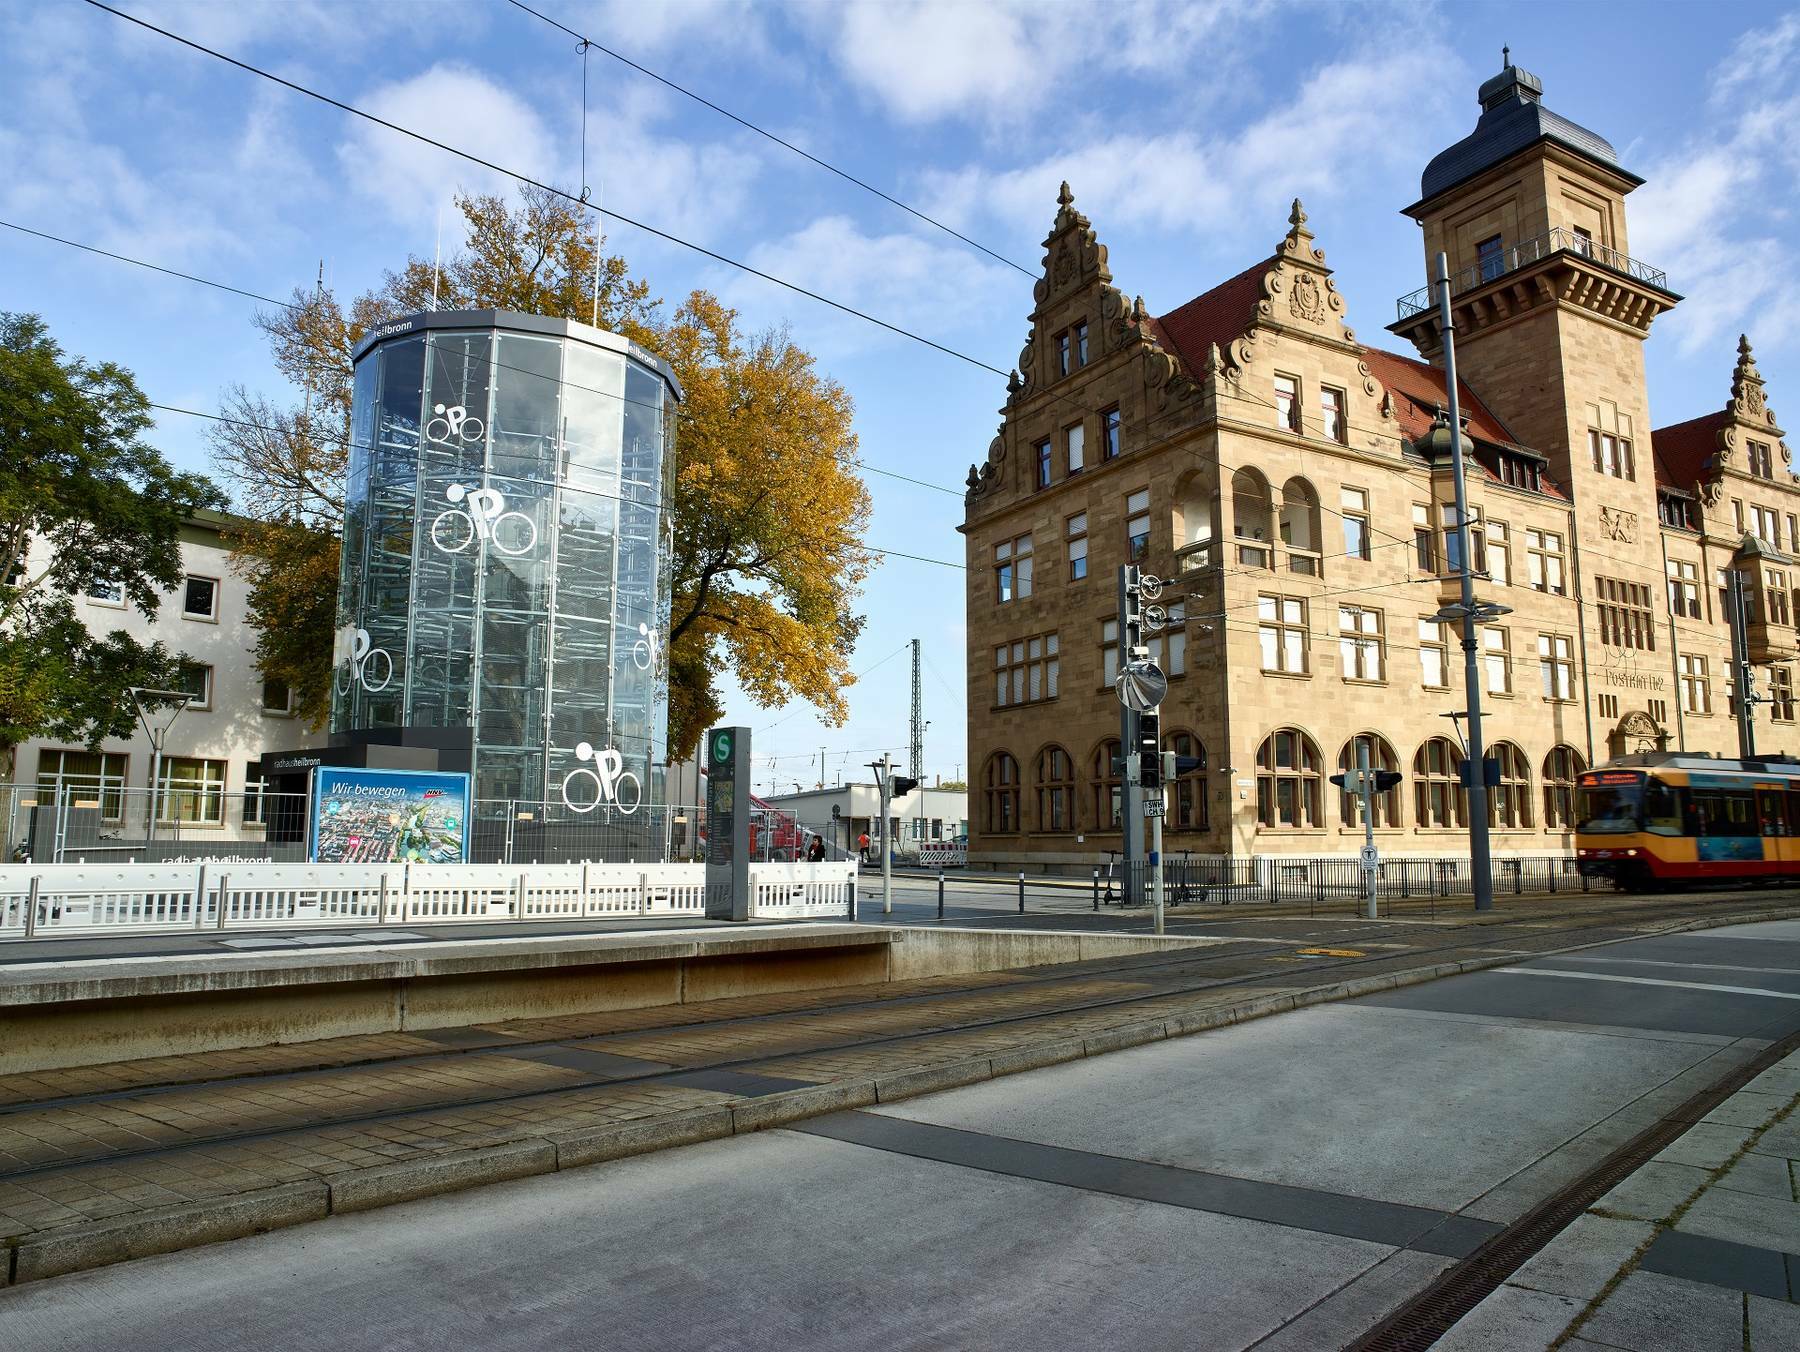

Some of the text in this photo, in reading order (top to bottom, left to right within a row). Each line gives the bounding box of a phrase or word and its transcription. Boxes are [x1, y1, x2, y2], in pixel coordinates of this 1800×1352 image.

[716, 734, 731, 761] S
[332, 782, 406, 799] Wir bewegen
